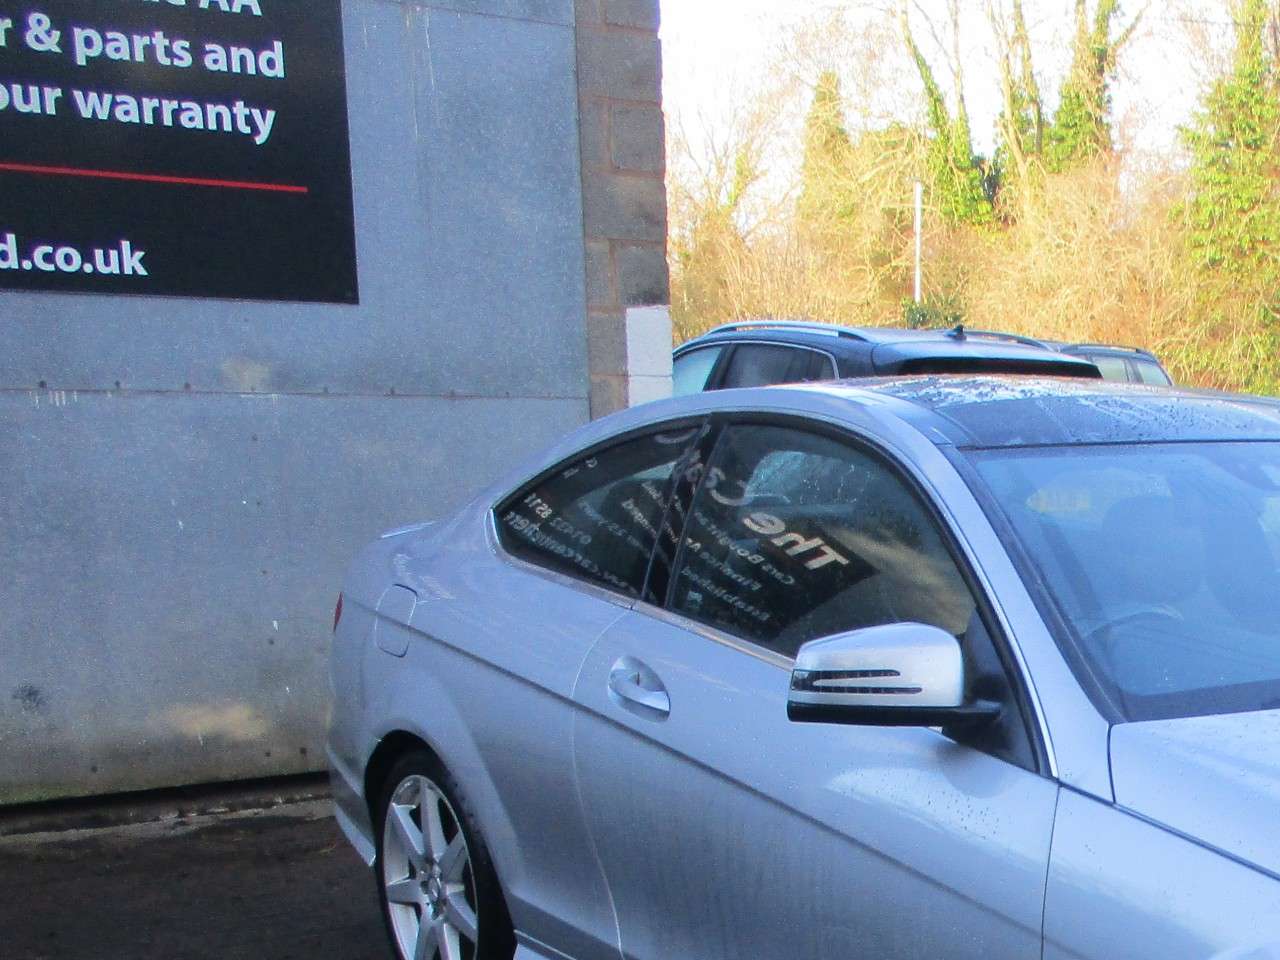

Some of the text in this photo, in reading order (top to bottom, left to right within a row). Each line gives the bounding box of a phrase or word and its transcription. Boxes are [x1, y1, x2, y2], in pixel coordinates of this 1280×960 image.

[24, 12, 62, 53] &
[72, 26, 193, 68] parts
[203, 40, 286, 79] and
[72, 88, 277, 145] warranty
